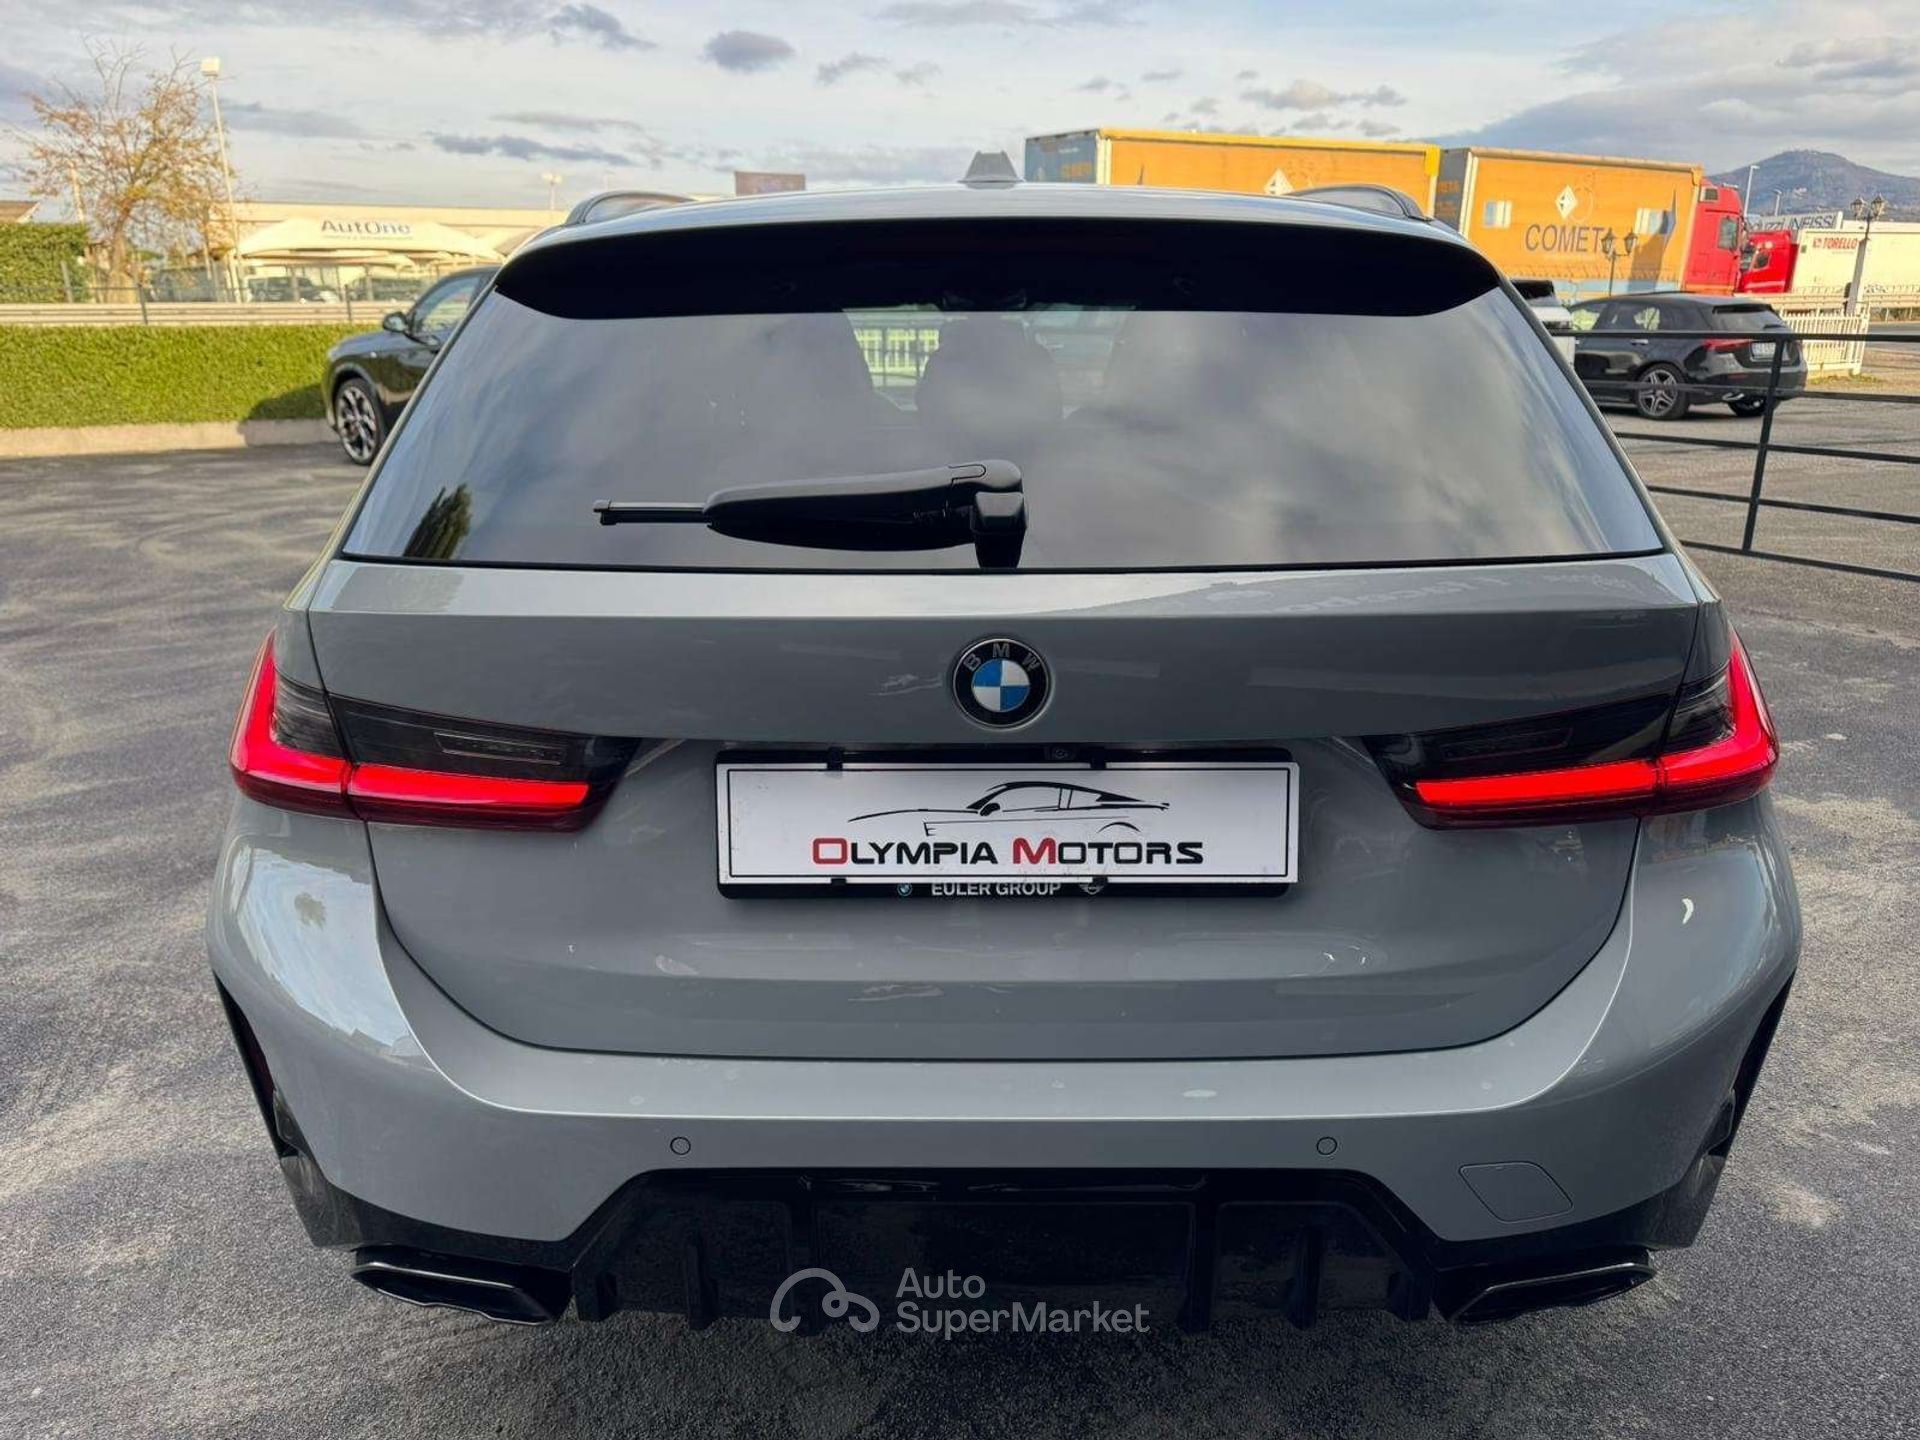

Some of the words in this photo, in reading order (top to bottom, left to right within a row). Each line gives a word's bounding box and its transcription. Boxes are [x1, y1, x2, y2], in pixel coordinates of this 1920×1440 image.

[1524, 223, 1616, 254] COMET
[963, 642, 1040, 672] BMW
[812, 837, 999, 865] OLYMPIA
[1012, 837, 1204, 865] MOTORS
[931, 882, 991, 896] EULER
[995, 882, 1061, 896] GROUP
